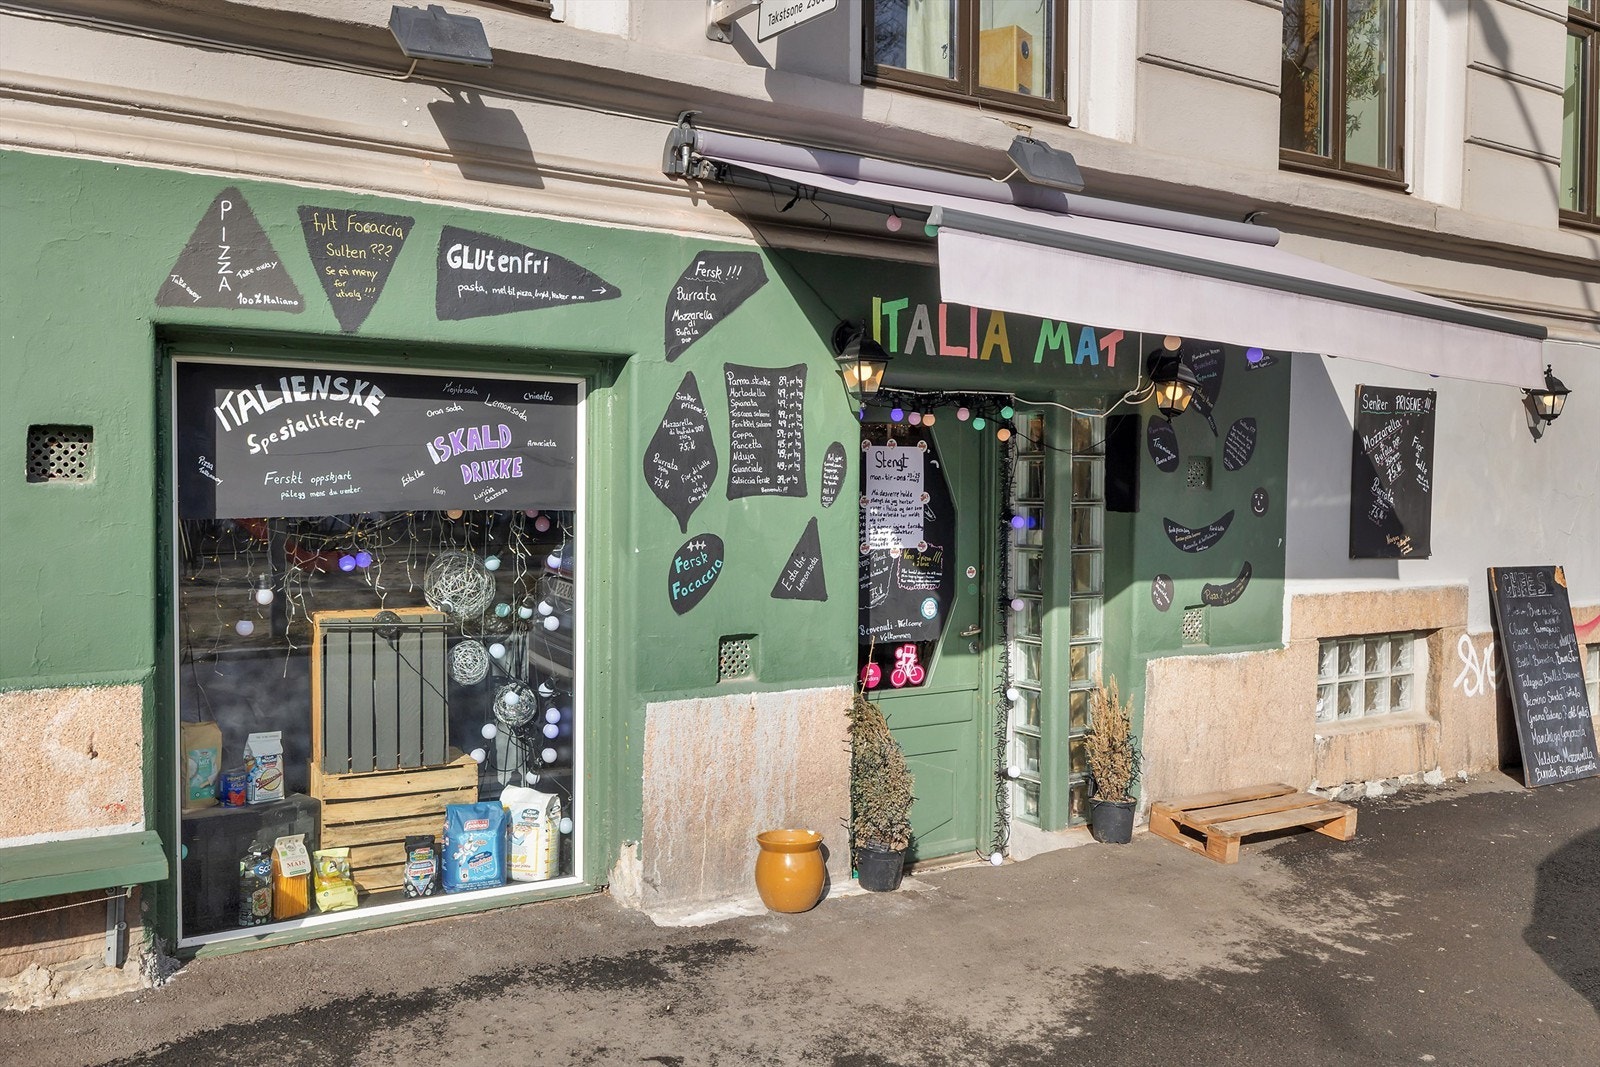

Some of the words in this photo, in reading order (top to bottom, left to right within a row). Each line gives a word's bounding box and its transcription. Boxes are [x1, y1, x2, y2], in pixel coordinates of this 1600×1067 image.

[768, 2, 803, 26] Takstsone
[313, 213, 338, 236] fylt
[326, 244, 366, 259] Sulten
[370, 244, 394, 262] ???
[326, 266, 336, 277] Se
[352, 269, 378, 282] meny
[695, 260, 722, 280] Fersk
[725, 265, 742, 280] !!!
[334, 279, 346, 288] for
[458, 280, 488, 298] pasta,
[335, 290, 362, 301] utvalg
[676, 286, 717, 301] Burrata
[672, 309, 714, 322] Mozzarella
[675, 327, 699, 336] Bufala
[872, 296, 1012, 364] ITALIA
[1033, 319, 1124, 368] MAT
[729, 387, 766, 397] Mortadella
[214, 374, 386, 432] ITALIENSKE
[445, 402, 464, 413] soda
[484, 393, 512, 412] Lemon
[510, 406, 528, 422] soda
[1362, 394, 1388, 410] Senker
[1395, 395, 1422, 410] PRISENE
[247, 410, 366, 455] Spesialiteter
[732, 431, 754, 439] Coppa
[1363, 418, 1402, 451] Mozzarella
[426, 423, 512, 465] ISKALD
[653, 452, 678, 470] Burrata
[875, 450, 909, 471] Stengt
[264, 470, 303, 486] Ferskt
[460, 456, 523, 485] DRIKKE
[674, 552, 708, 574] Fersk
[672, 559, 723, 600] Focaccia
